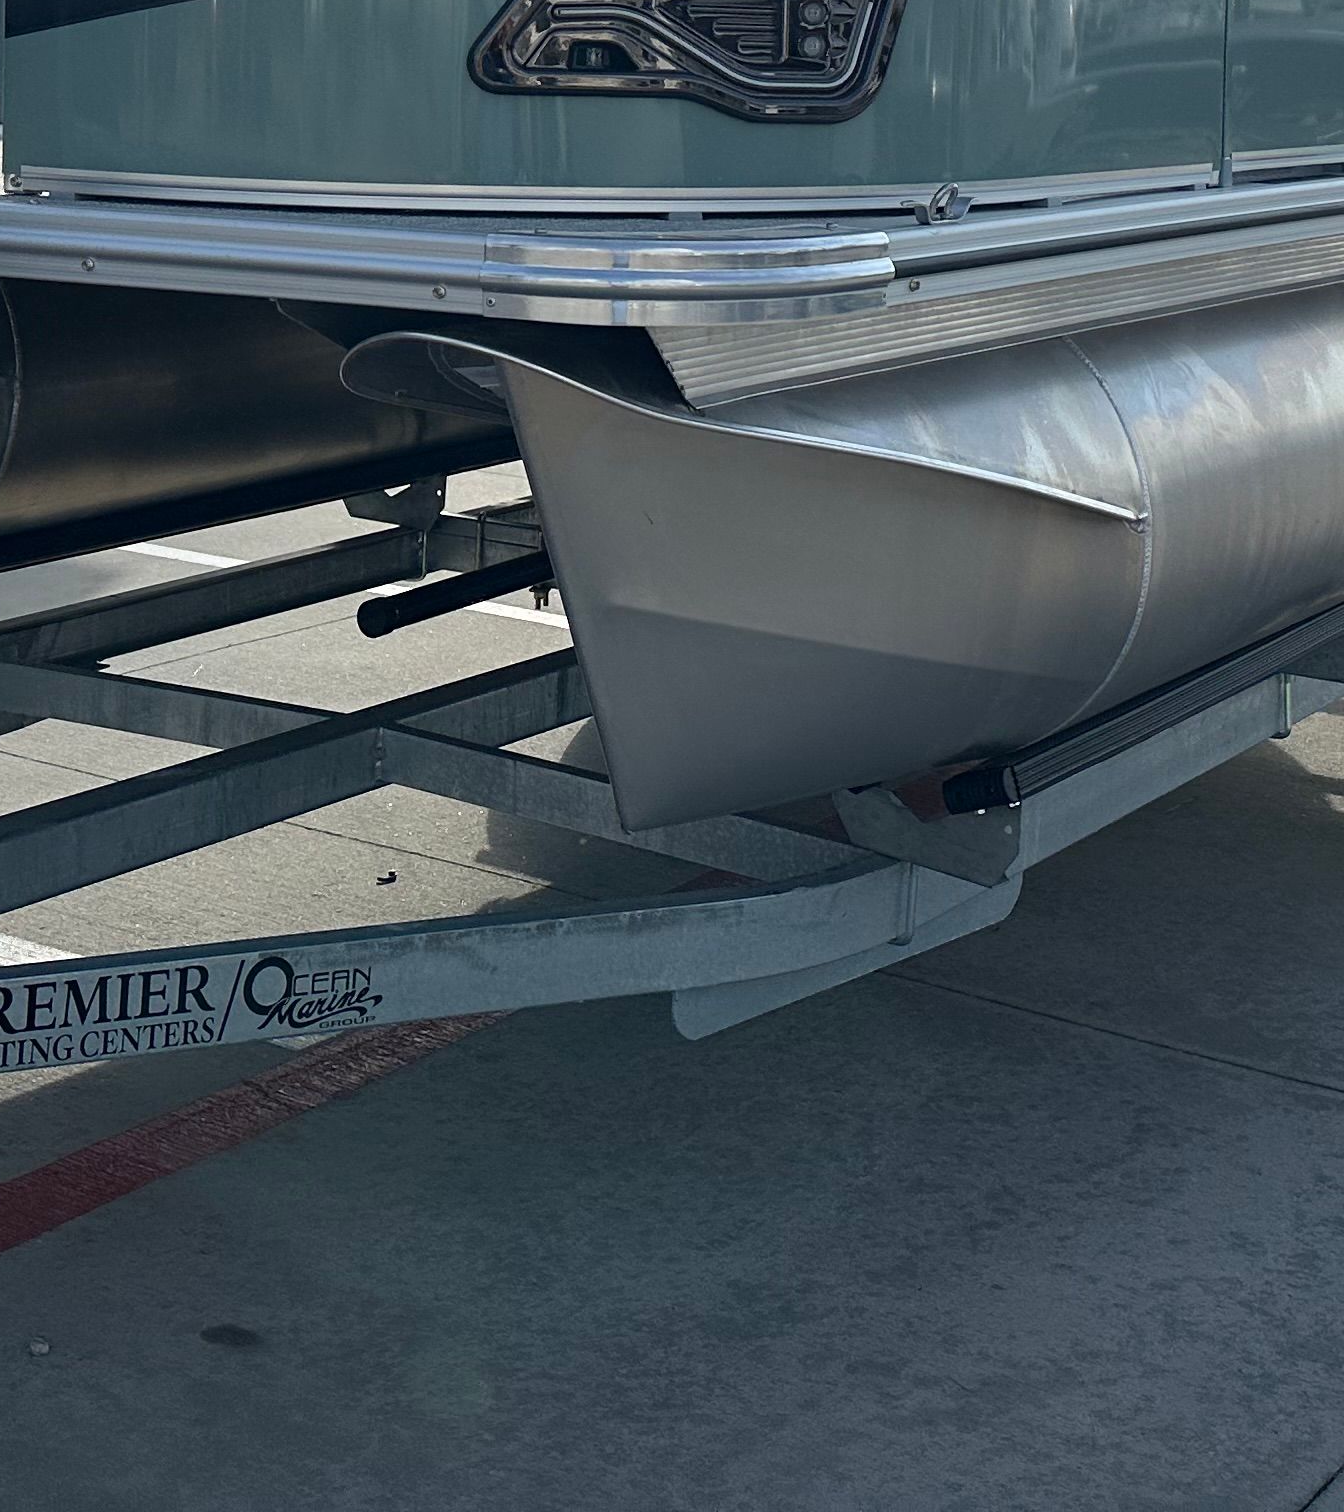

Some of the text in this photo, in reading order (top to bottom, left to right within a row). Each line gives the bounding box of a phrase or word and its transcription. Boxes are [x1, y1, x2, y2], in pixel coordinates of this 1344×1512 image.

[243, 956, 372, 1016] OCEAN
[257, 986, 383, 1030] Marine
[319, 1016, 376, 1029] GROUP
[79, 1017, 216, 1058] CENTERS
